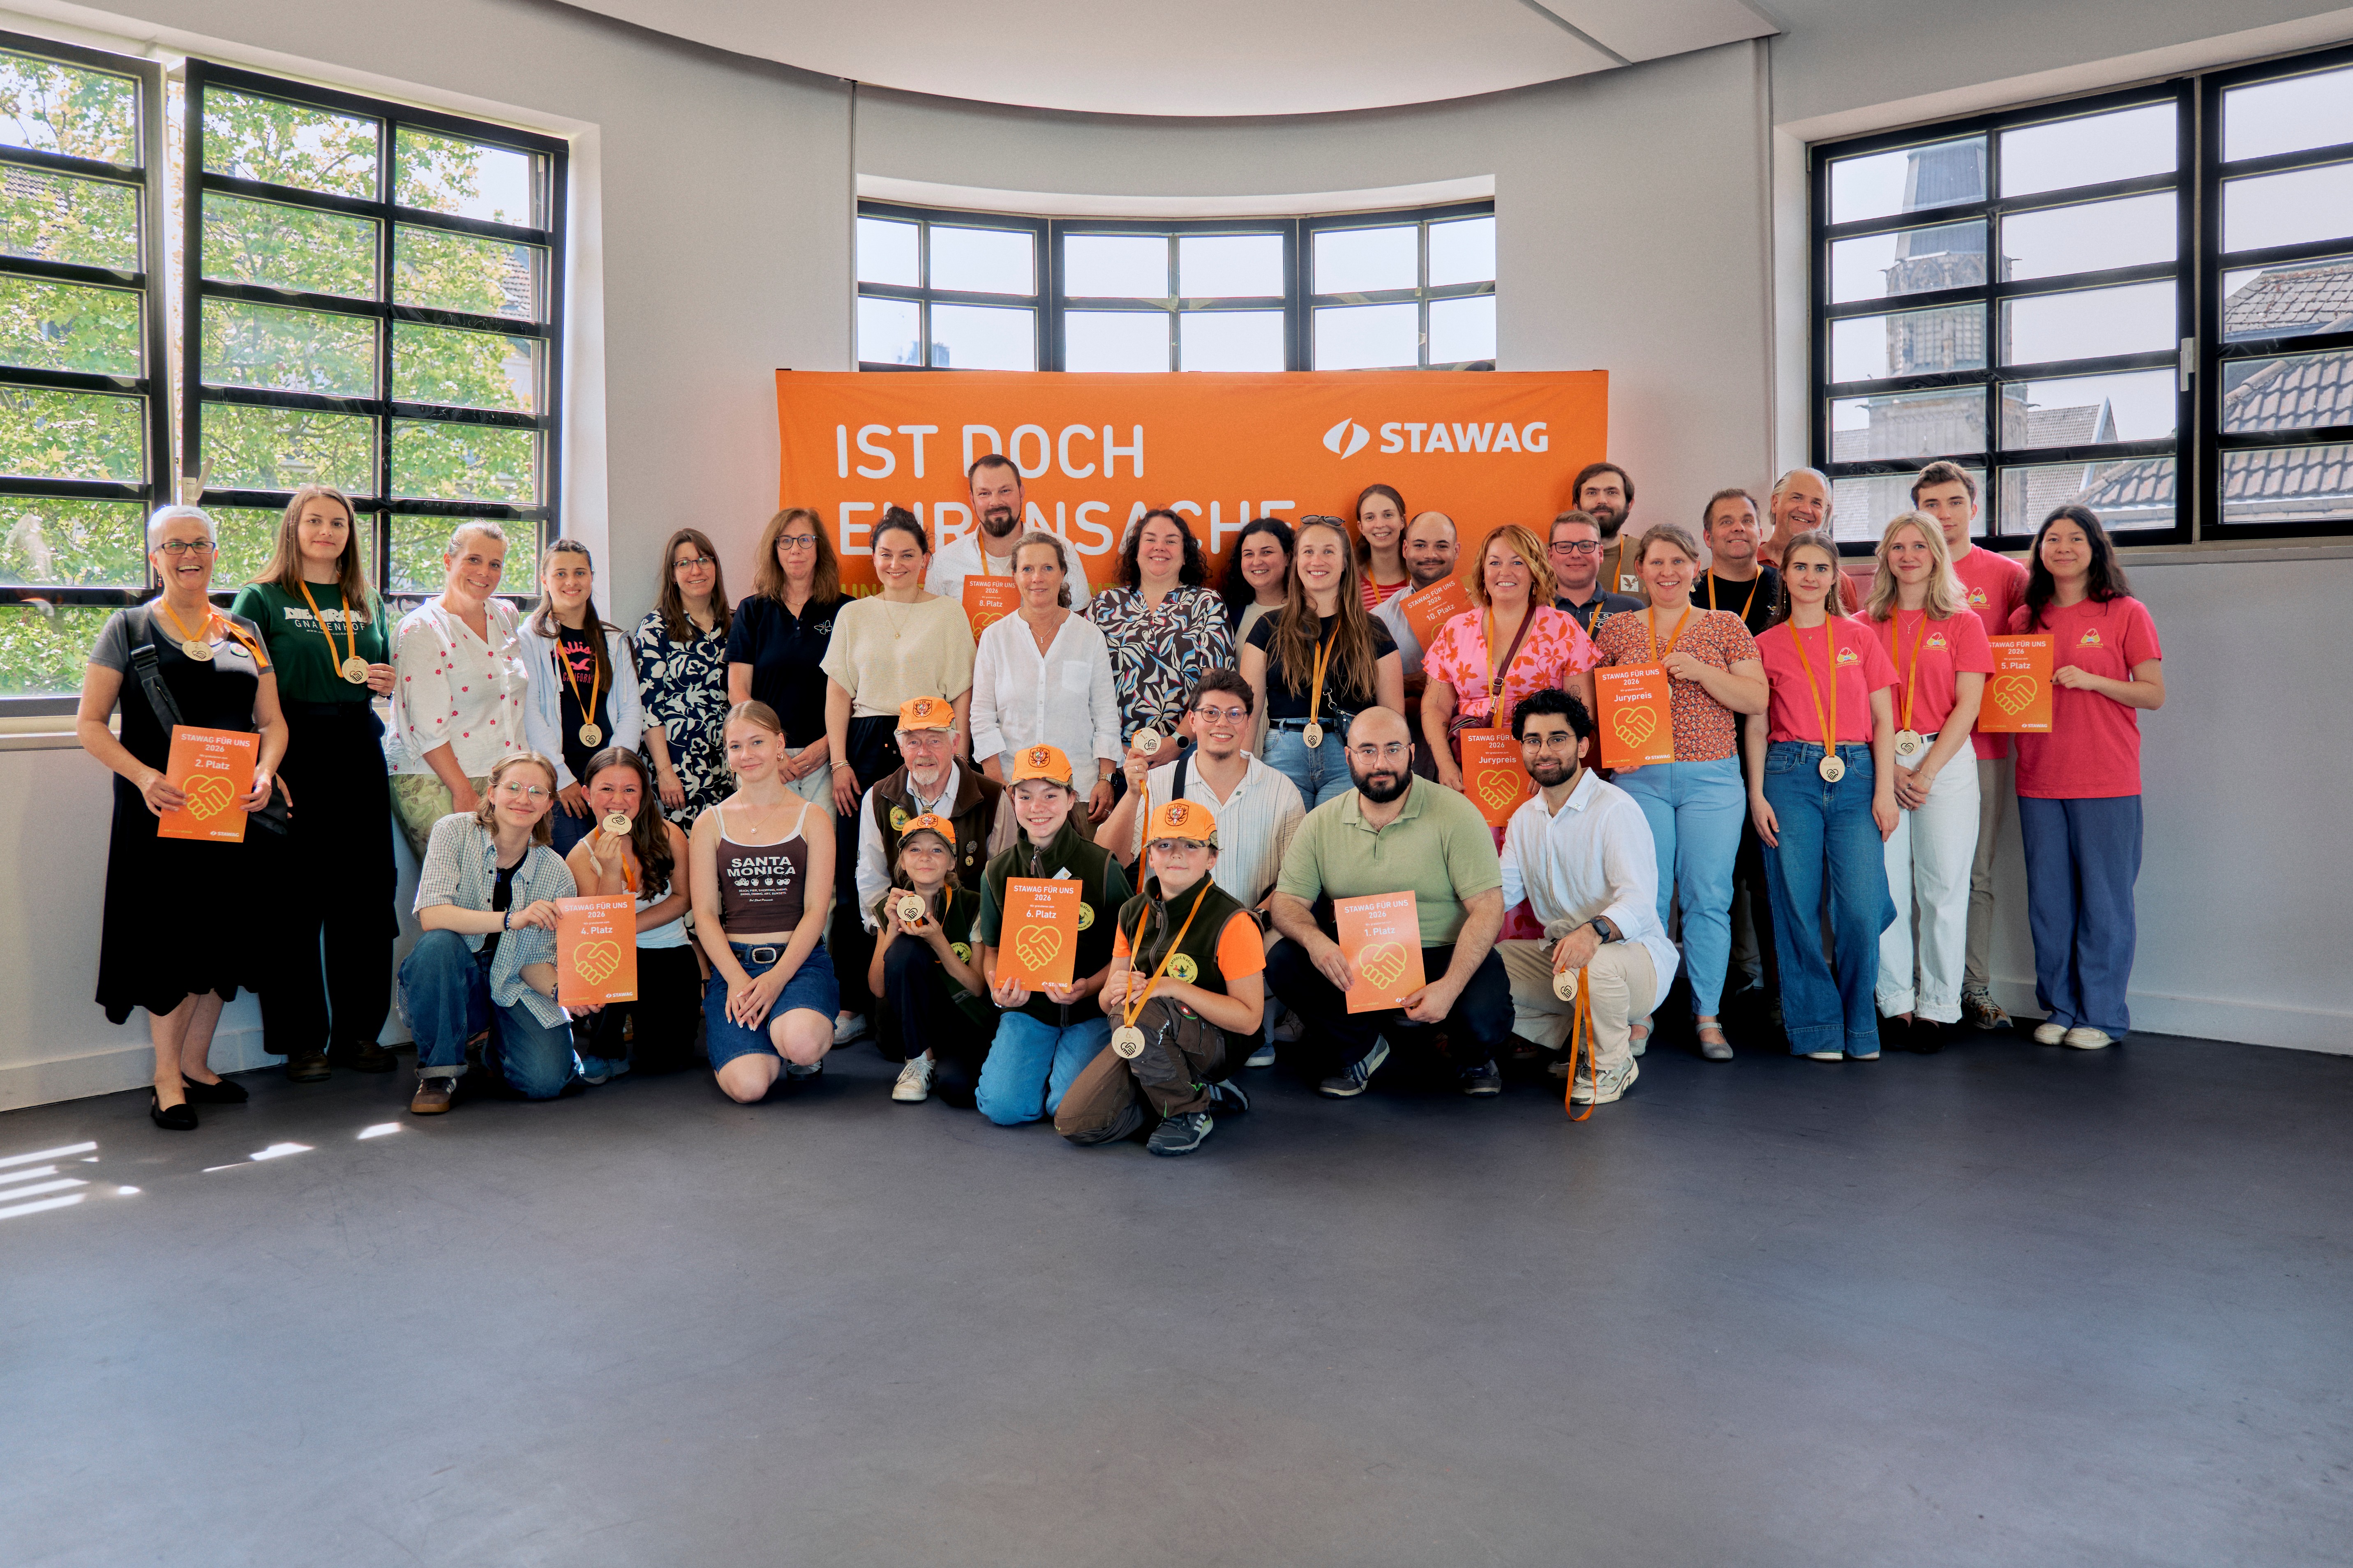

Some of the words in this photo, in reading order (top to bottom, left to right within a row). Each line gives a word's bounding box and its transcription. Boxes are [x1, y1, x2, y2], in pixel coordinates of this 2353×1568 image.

[1380, 422, 1548, 453] STAWAG
[836, 424, 939, 479] IST
[963, 424, 1144, 479] DOCH
[839, 500, 1295, 556] ERNSCH
[1408, 593, 1430, 609] STAWAG
[1431, 588, 1443, 597] FÜR
[1443, 581, 1455, 590] UNS
[1427, 596, 1441, 606] 2026
[284, 607, 313, 620] DIE
[1437, 604, 1455, 616] Platz
[1602, 672, 1629, 680] STAWAG
[1614, 692, 1652, 702] Jurypreis
[181, 734, 214, 743] STAWAG
[206, 760, 230, 770] Platz
[1479, 756, 1516, 765] Jurypreis
[891, 807, 903, 816] Lerno
[732, 856, 792, 867] SANTA
[727, 867, 796, 877] MONICA
[1344, 904, 1374, 913] STAWAG
[1376, 901, 1391, 909] FÜR
[1036, 910, 1056, 918] Platz
[1373, 927, 1395, 936] Platz
[1169, 956, 1182, 966] Lernort
[1182, 956, 1193, 966] Natur
